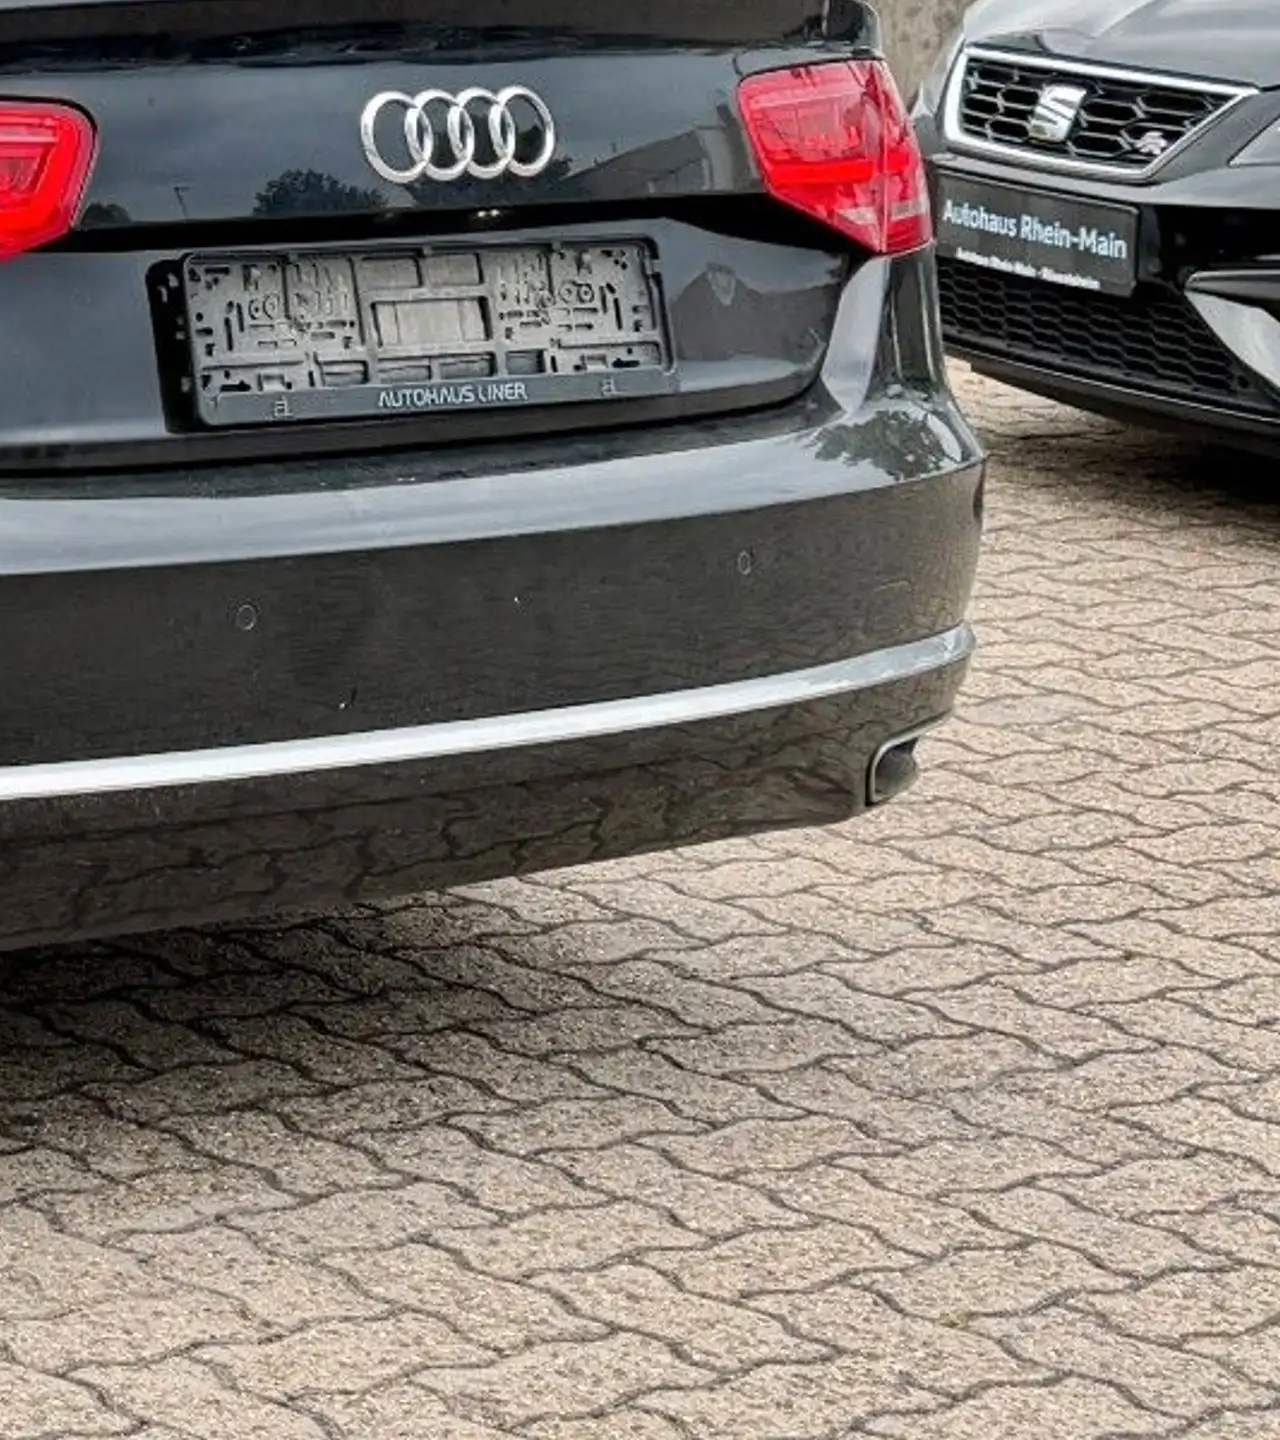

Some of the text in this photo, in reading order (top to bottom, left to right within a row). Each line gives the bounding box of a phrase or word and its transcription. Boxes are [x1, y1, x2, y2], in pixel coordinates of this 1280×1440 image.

[943, 199, 1127, 259] Autohaus Rhein-Main
[378, 382, 528, 407] AUTOHAUS LINER
